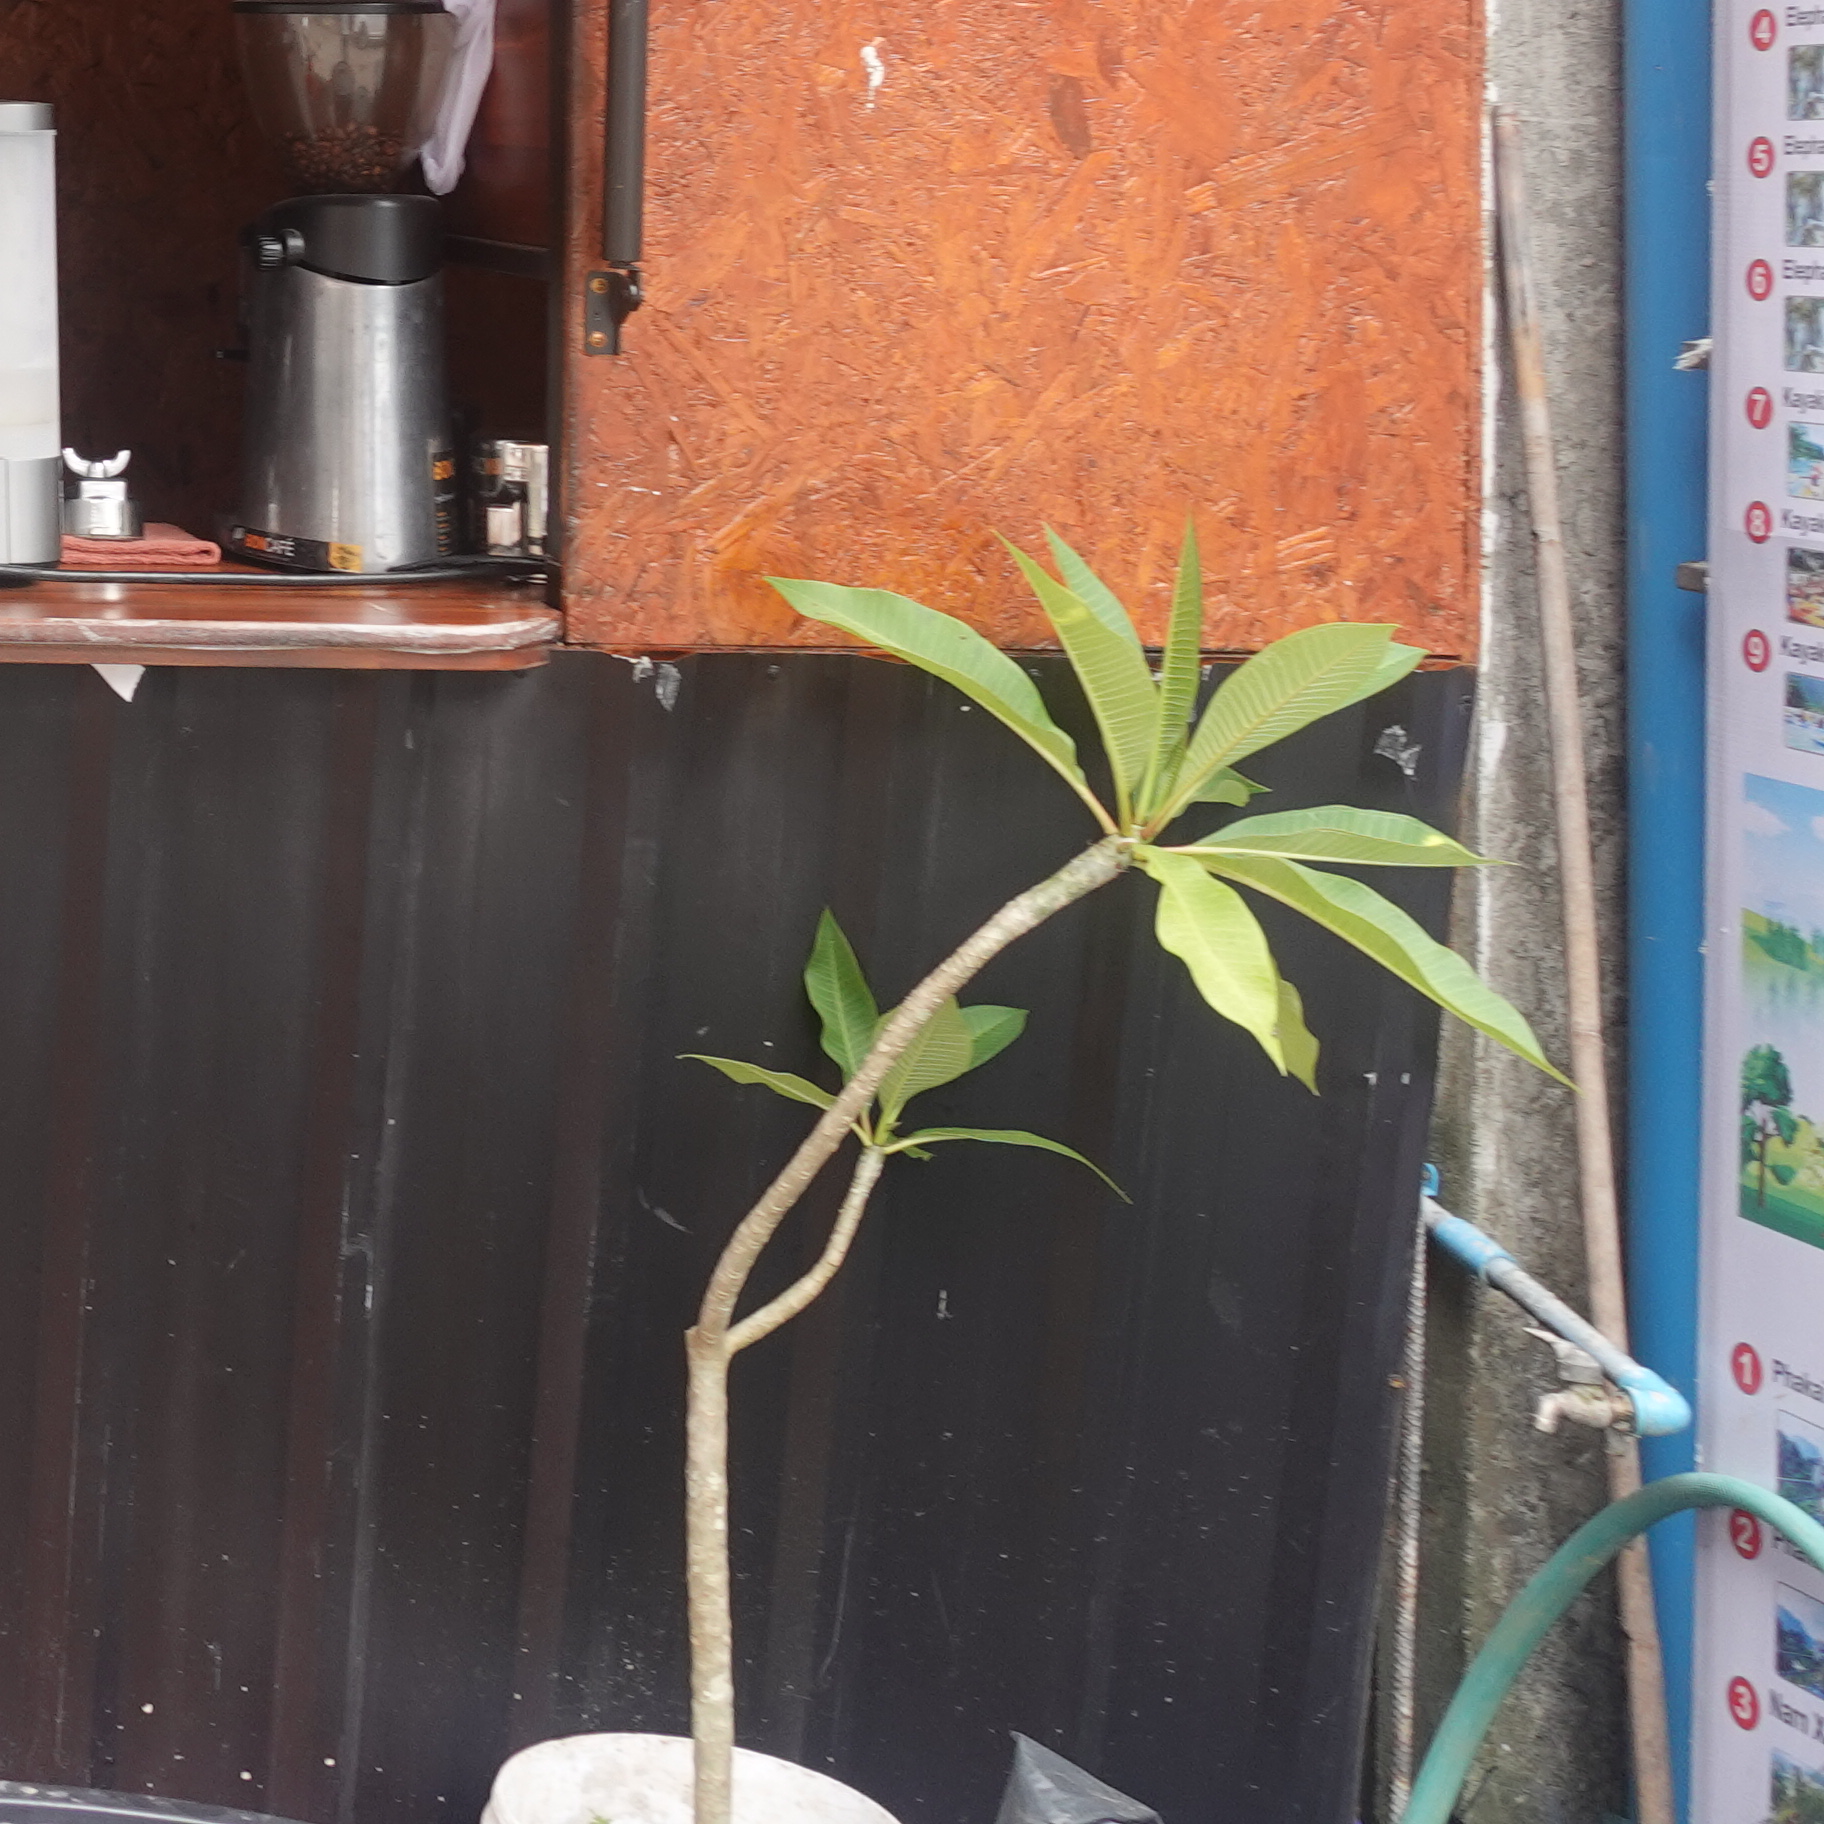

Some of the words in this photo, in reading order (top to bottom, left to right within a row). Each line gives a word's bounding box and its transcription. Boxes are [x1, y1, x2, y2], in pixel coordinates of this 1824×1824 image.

[1754, 16, 1772, 45] 4
[1752, 143, 1770, 172] 5
[1750, 393, 1768, 422] 7
[1737, 1349, 1755, 1388] 1
[1734, 1515, 1756, 1553] 2
[1732, 1683, 1754, 1724] 3
